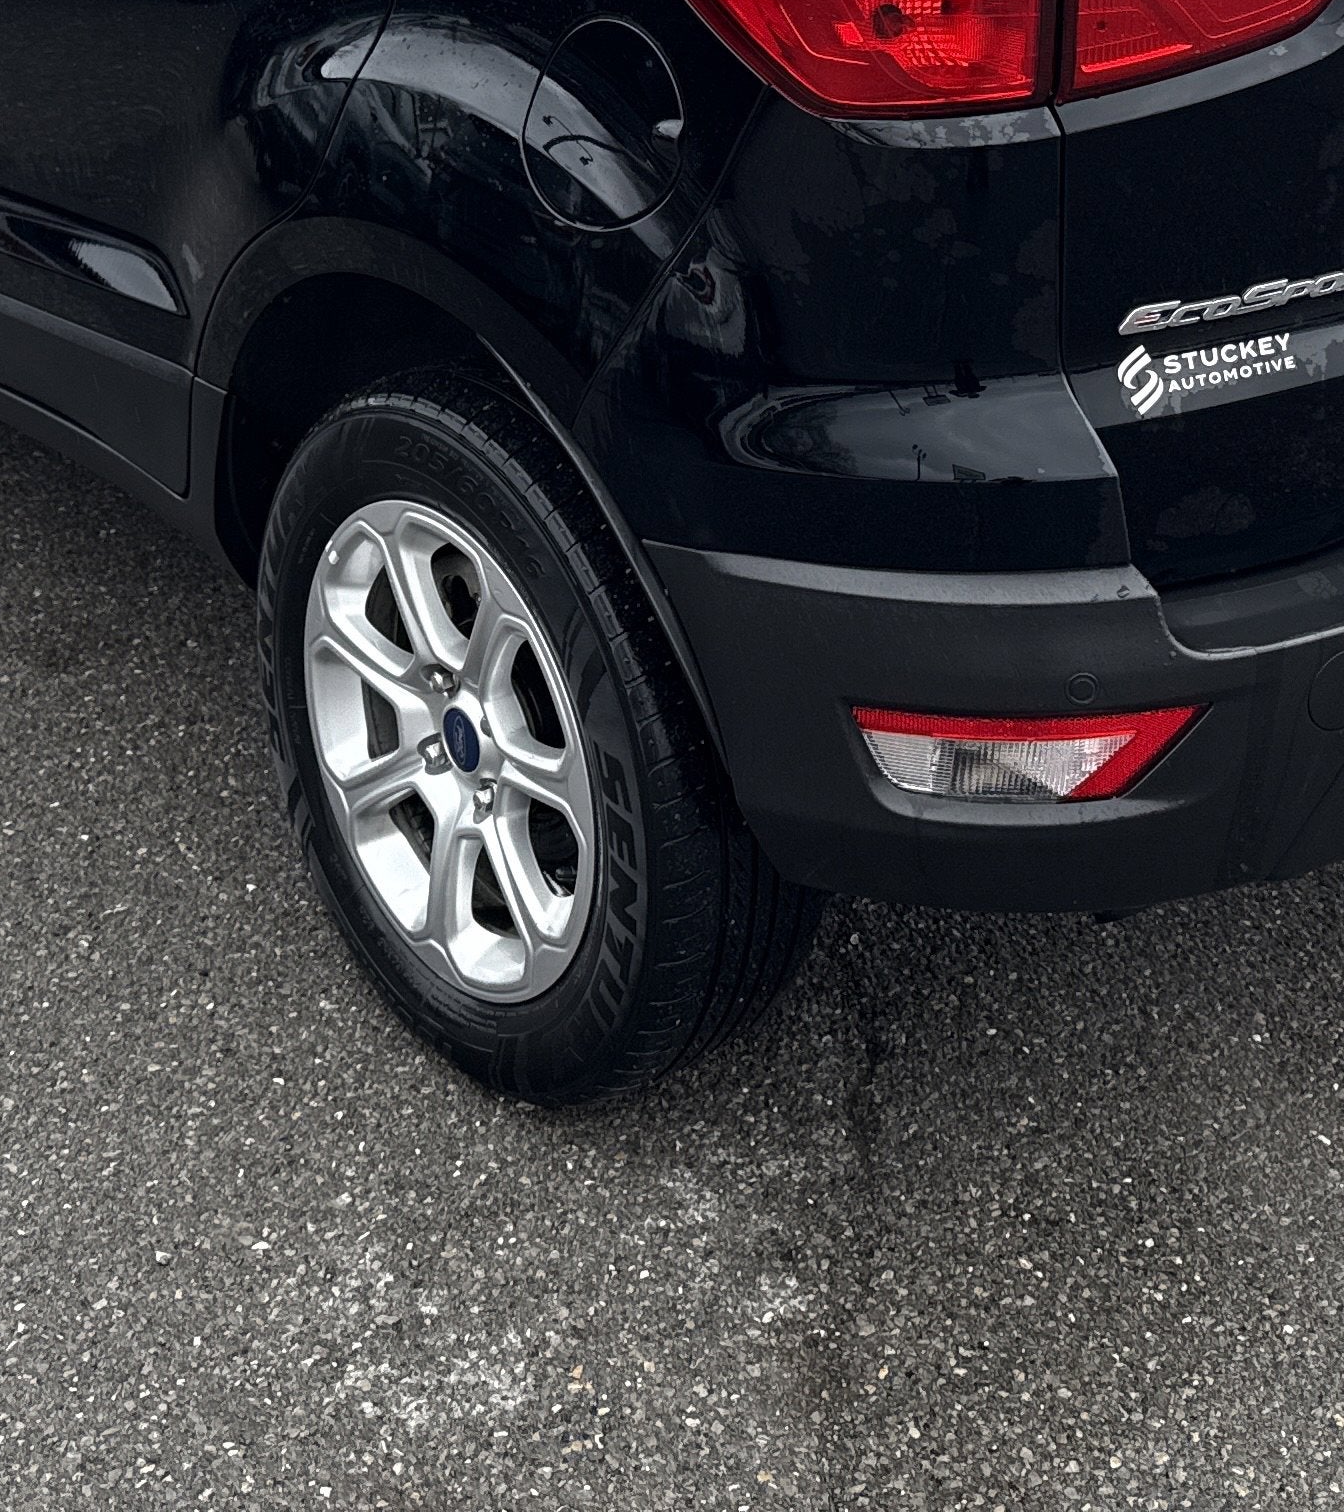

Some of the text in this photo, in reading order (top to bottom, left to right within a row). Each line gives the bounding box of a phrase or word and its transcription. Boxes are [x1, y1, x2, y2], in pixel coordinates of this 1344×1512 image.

[1163, 333, 1290, 374] STUCKEY
[1168, 356, 1296, 393] AUTOMOTIVE
[586, 741, 638, 1054] SENTUR
